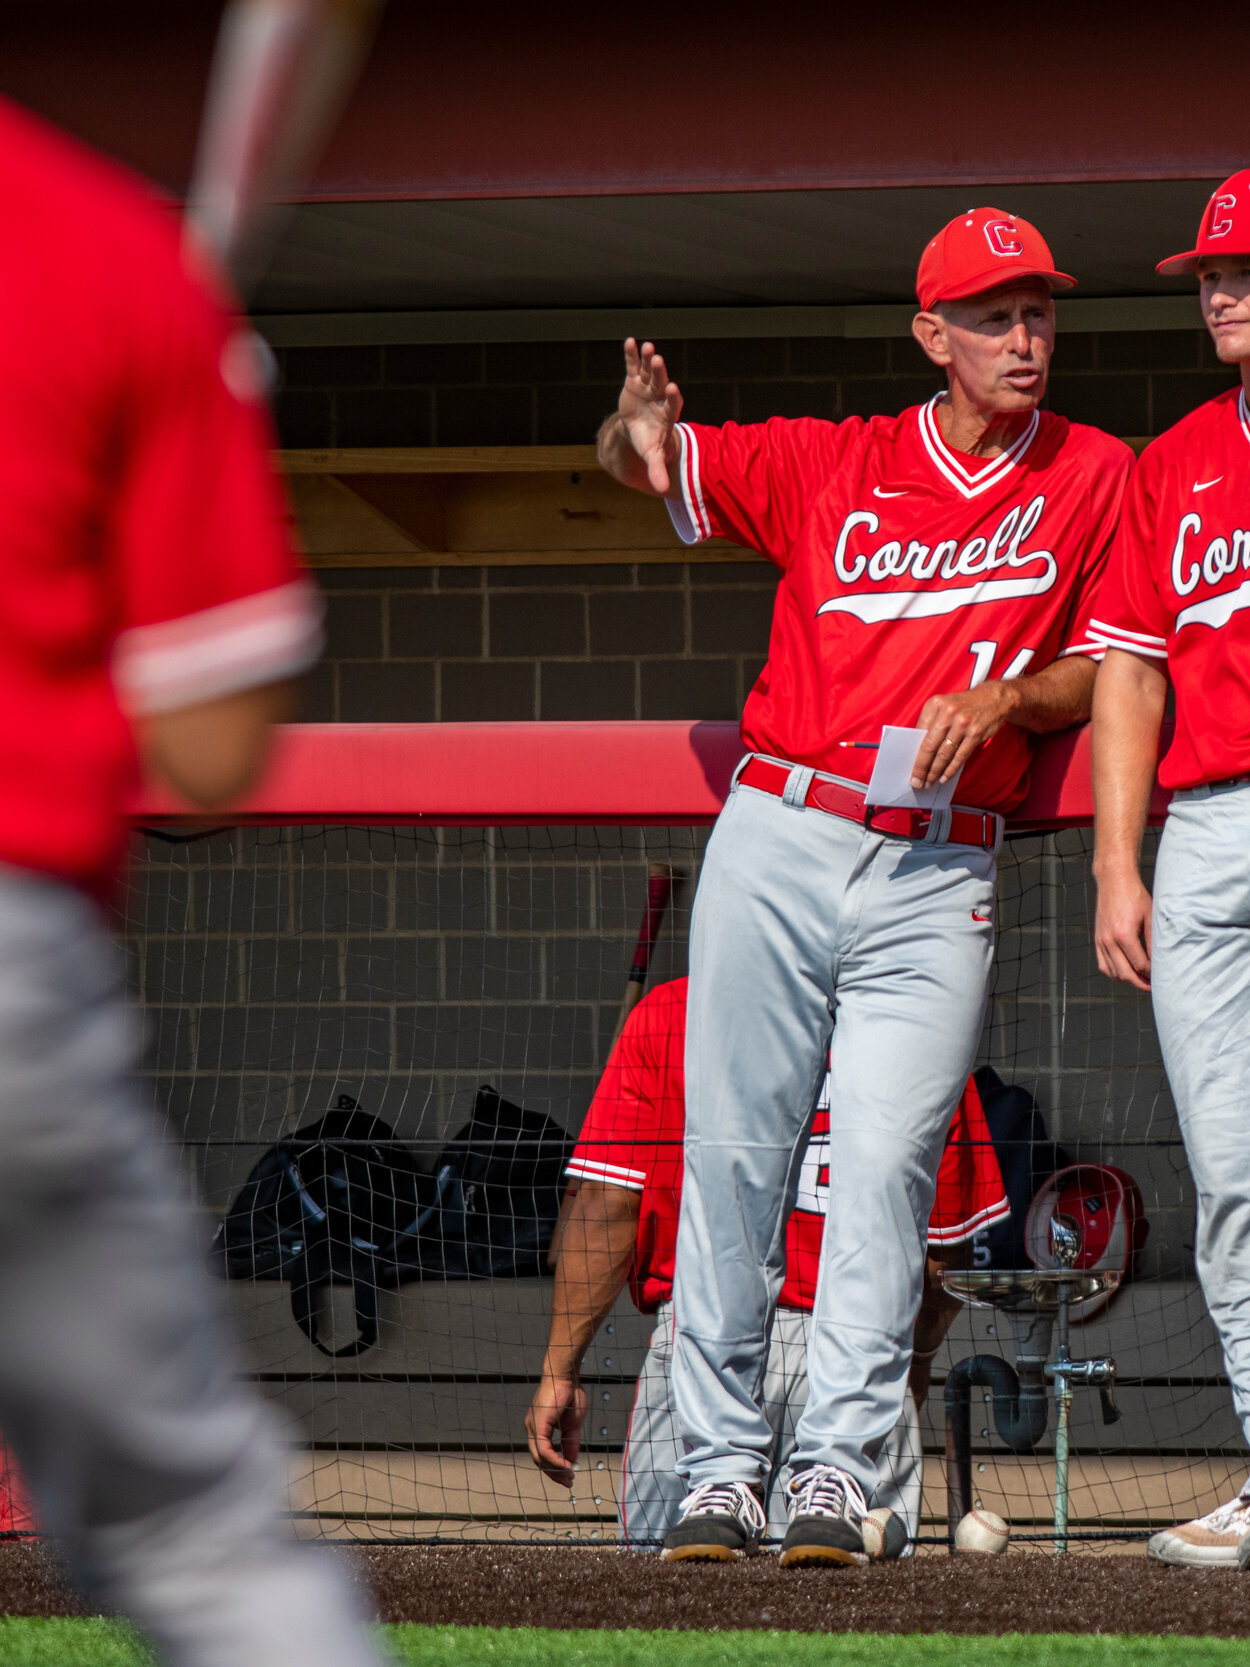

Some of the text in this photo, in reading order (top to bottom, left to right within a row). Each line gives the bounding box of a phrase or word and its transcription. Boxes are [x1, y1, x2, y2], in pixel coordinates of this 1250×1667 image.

[983, 220, 1024, 257] C
[1206, 193, 1238, 240] C
[834, 495, 1057, 584] Cornell
